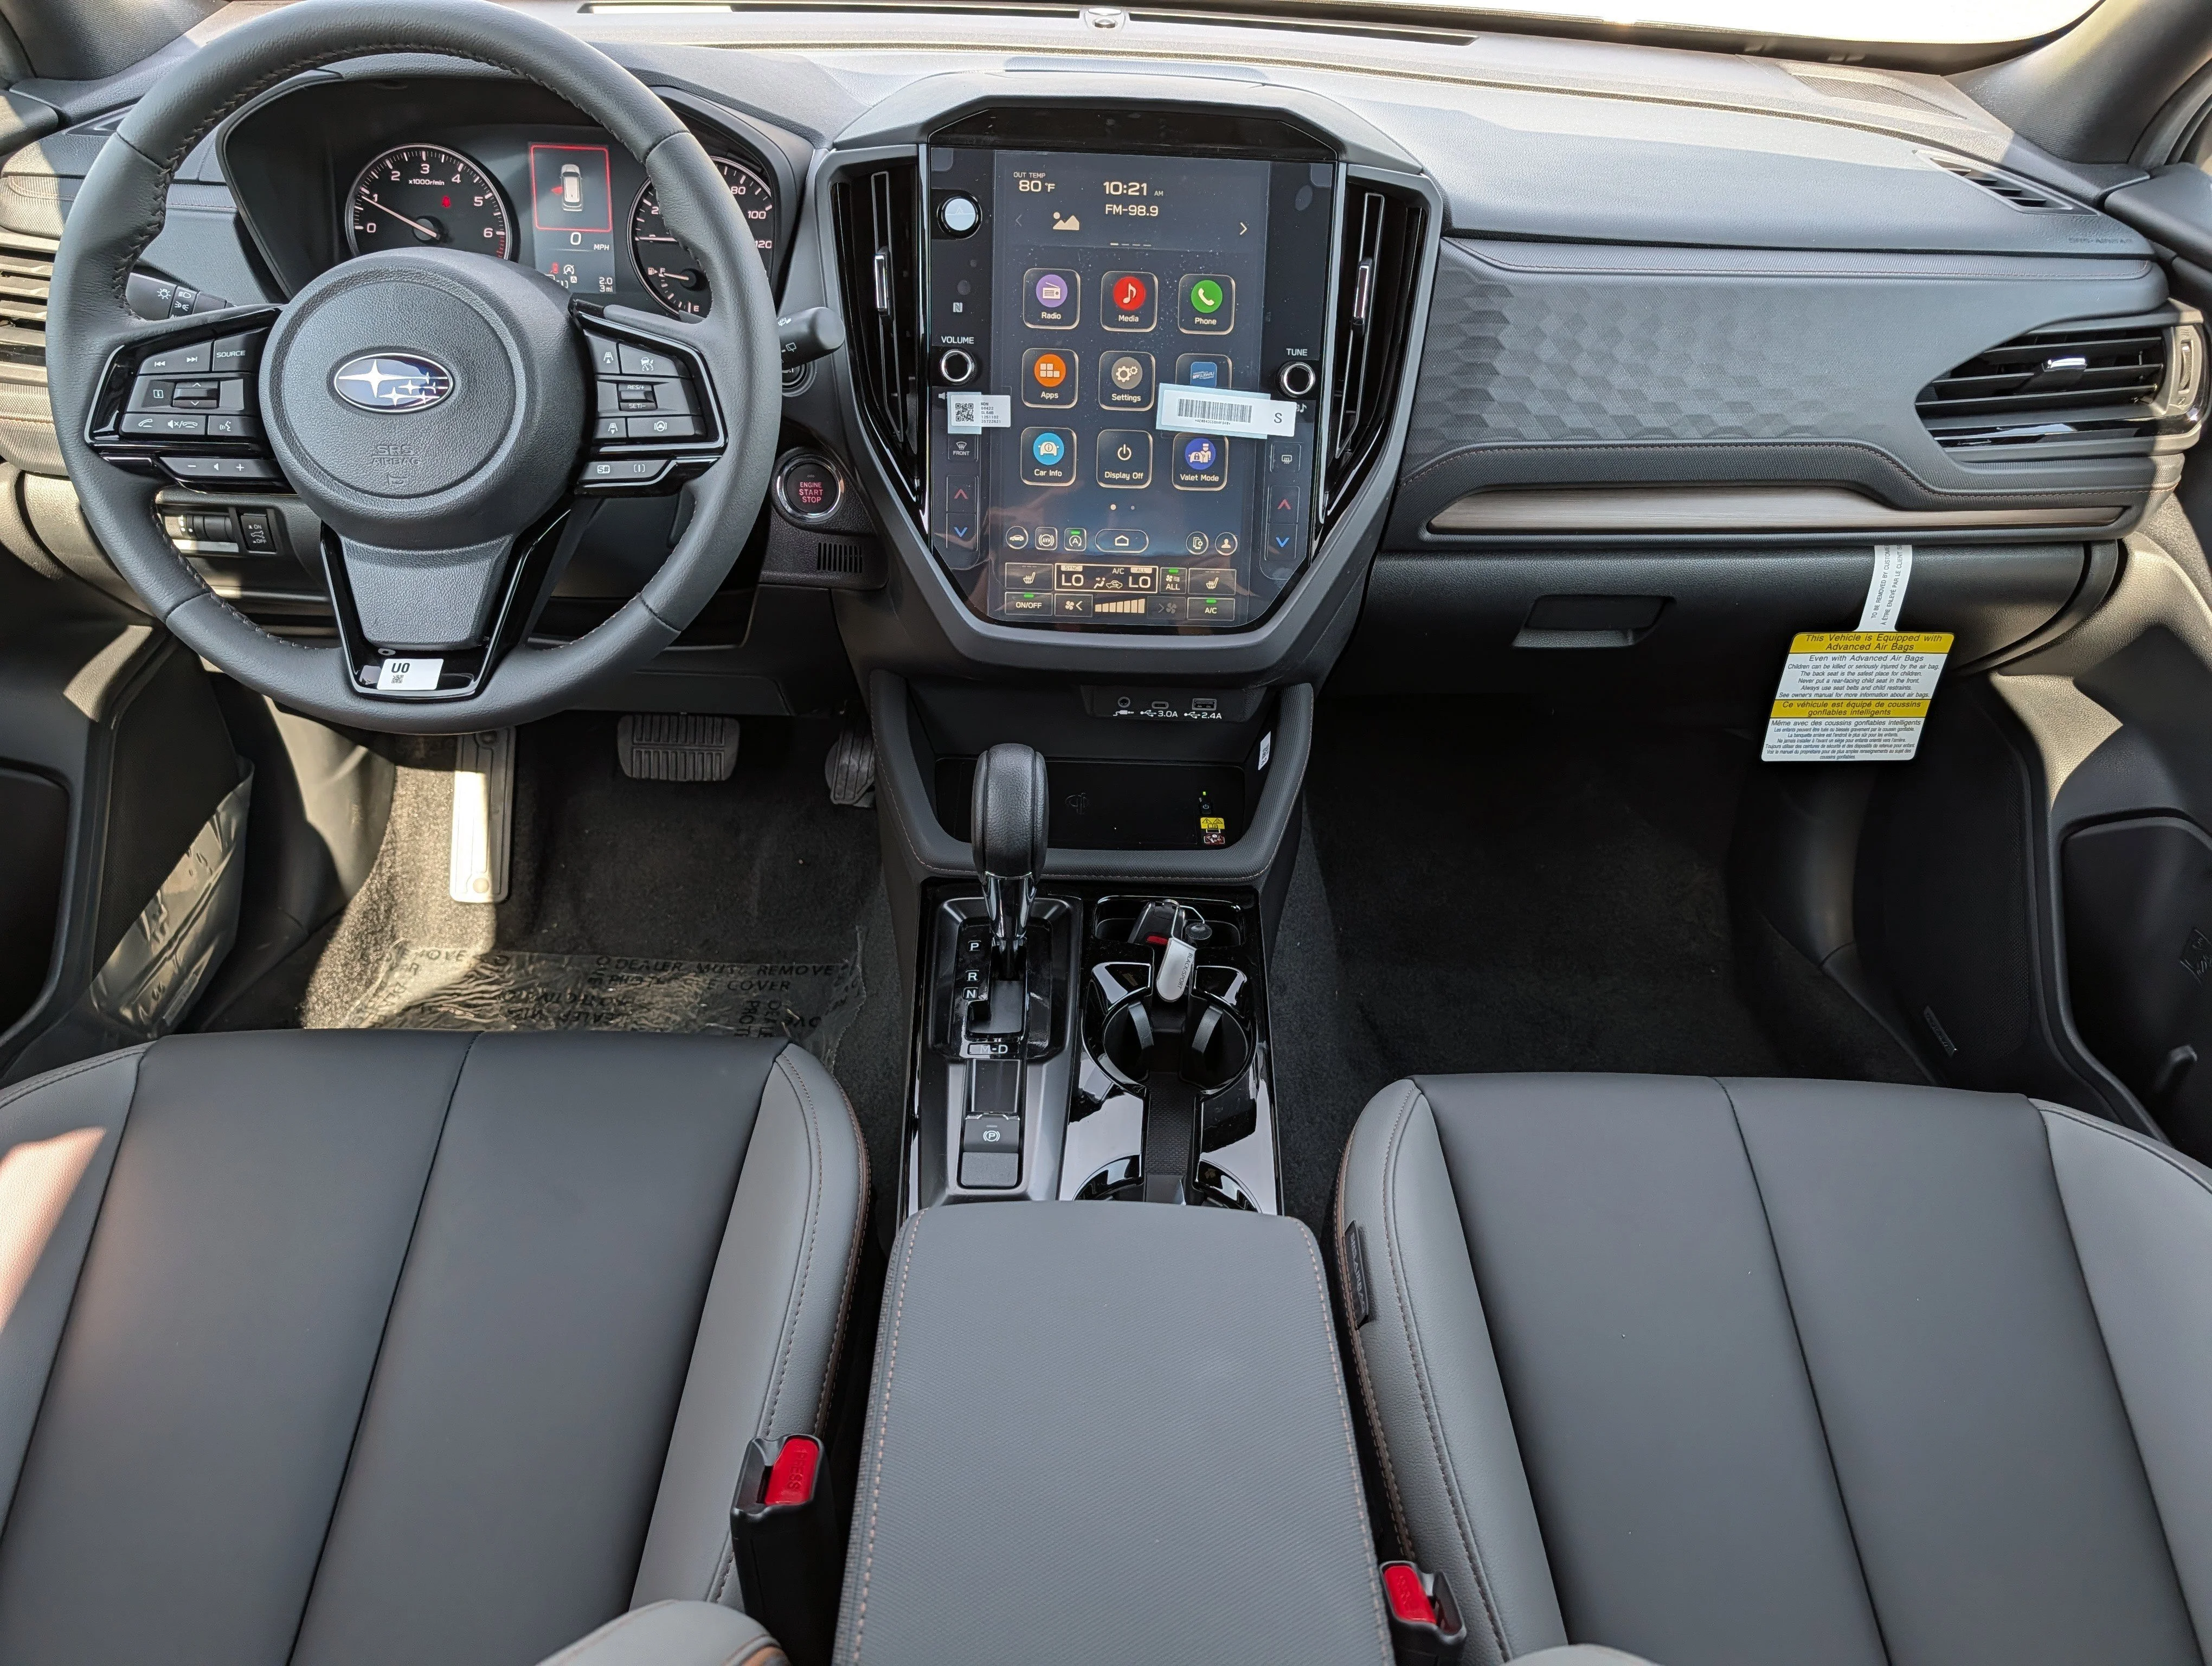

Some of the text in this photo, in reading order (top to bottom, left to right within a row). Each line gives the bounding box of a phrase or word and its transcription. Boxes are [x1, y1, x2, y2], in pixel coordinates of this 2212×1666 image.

[420, 163, 430, 174] 3
[391, 171, 400, 181] 2
[451, 174, 461, 183] 4
[730, 186, 746, 195] 80
[1018, 180, 1041, 192] 80
[1103, 181, 1148, 196] 10:21
[372, 194, 378, 202] 1
[474, 196, 483, 207] 5
[1105, 204, 1159, 216] FM-98.9
[748, 211, 767, 219] 100
[366, 223, 376, 233] 0
[483, 228, 493, 238] 6
[570, 232, 581, 246] 0
[755, 240, 772, 249] 120
[659, 267, 665, 275] F
[1041, 312, 1061, 320] Radio
[1118, 315, 1139, 323] Media
[1194, 317, 1217, 325] Phone
[216, 350, 246, 358] SOURCE
[1041, 391, 1059, 400] Apps
[1111, 393, 1141, 402] Settings
[1274, 413, 1282, 424] S
[376, 445, 415, 454] SRS
[371, 457, 421, 466] AIRBAG
[1034, 469, 1062, 477] Car Info
[1104, 471, 1144, 480] Display Off
[1180, 473, 1219, 482] Valet Mode
[1062, 574, 1084, 587] LO
[1128, 575, 1151, 589] LO
[1165, 583, 1180, 591] ALL
[1876, 580, 1886, 603] REMOVED
[1876, 634, 1920, 643] Equipped
[1891, 643, 1914, 652] Bags
[1904, 655, 1924, 663] Bags
[970, 943, 979, 951] P
[757, 964, 834, 976] REMOVE
[968, 972, 977, 981] R
[966, 990, 976, 998] N
